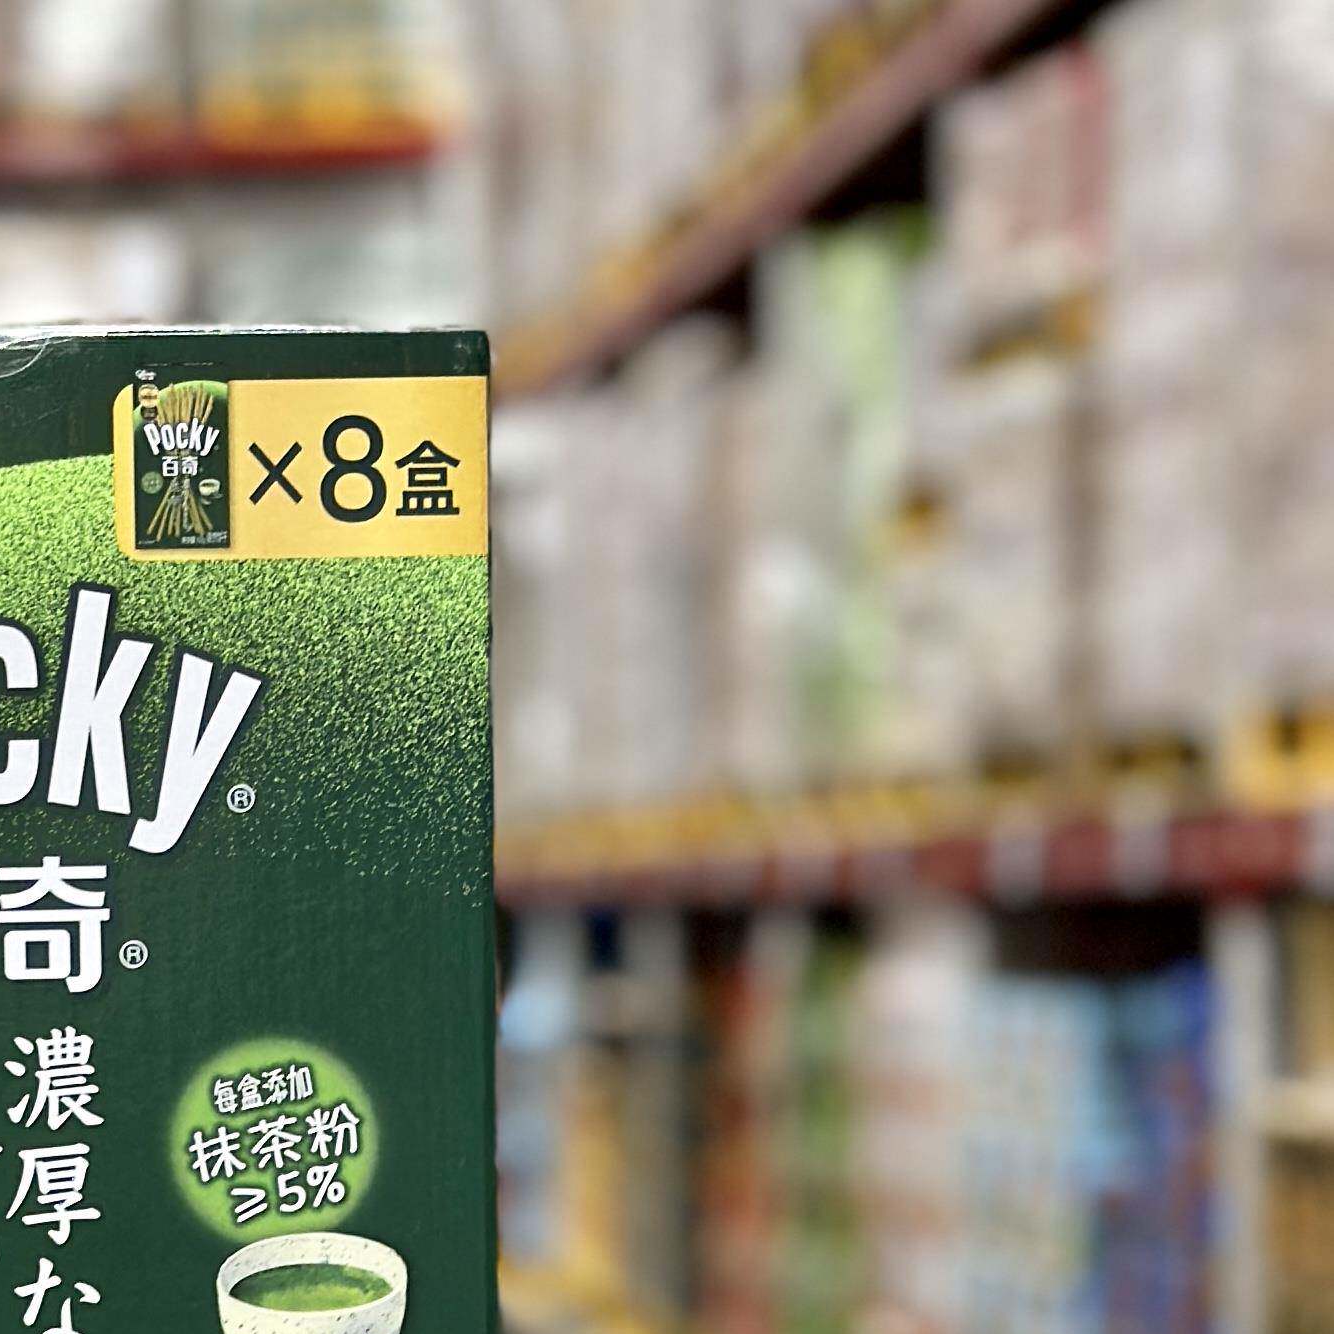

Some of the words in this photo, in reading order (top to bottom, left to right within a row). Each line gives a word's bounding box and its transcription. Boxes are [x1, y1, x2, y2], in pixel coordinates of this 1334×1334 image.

[143, 417, 220, 456] Pocky
[213, 1064, 314, 1114] 每盒添加
[188, 1102, 360, 1183] 抹茶粉
